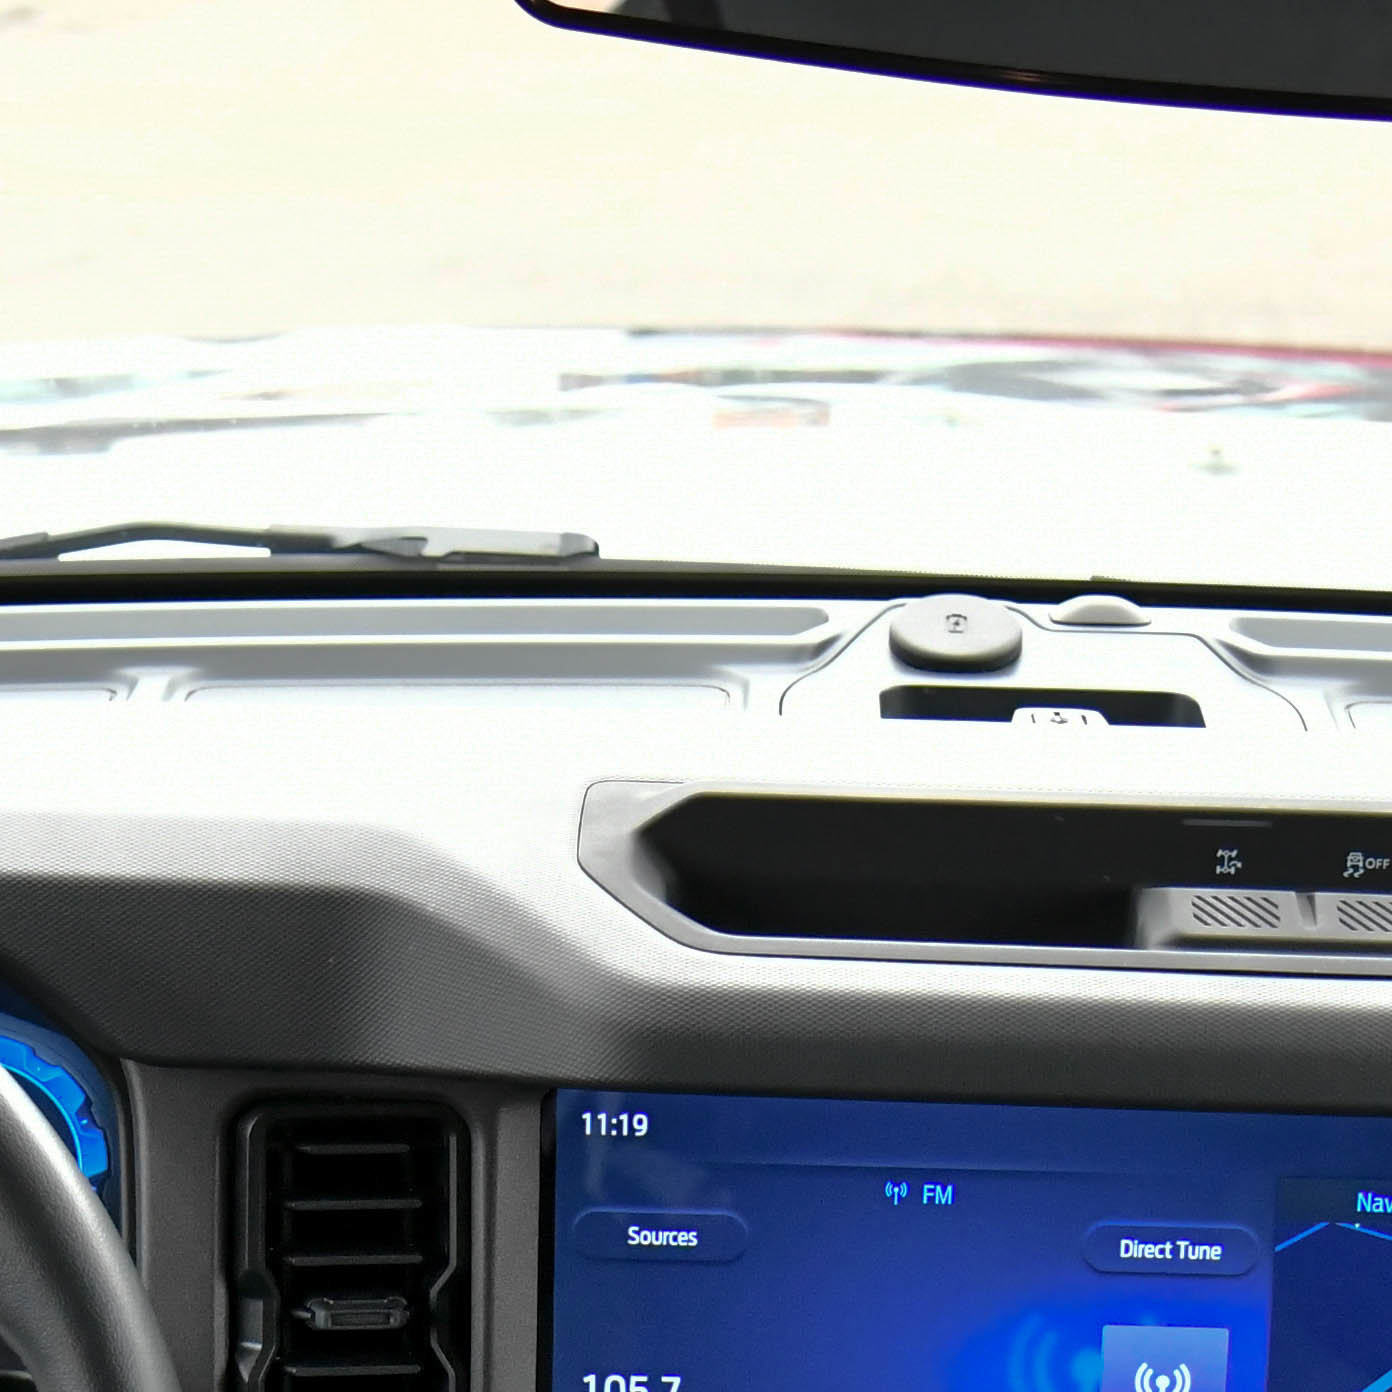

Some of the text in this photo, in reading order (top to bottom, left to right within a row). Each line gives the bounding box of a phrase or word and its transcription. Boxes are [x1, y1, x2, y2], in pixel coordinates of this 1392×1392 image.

[1365, 857, 1391, 871] OFF
[582, 1112, 649, 1137] 11:19
[922, 1184, 953, 1205] FM
[626, 1226, 698, 1247] Sources
[1119, 1239, 1222, 1261] Direct Tune
